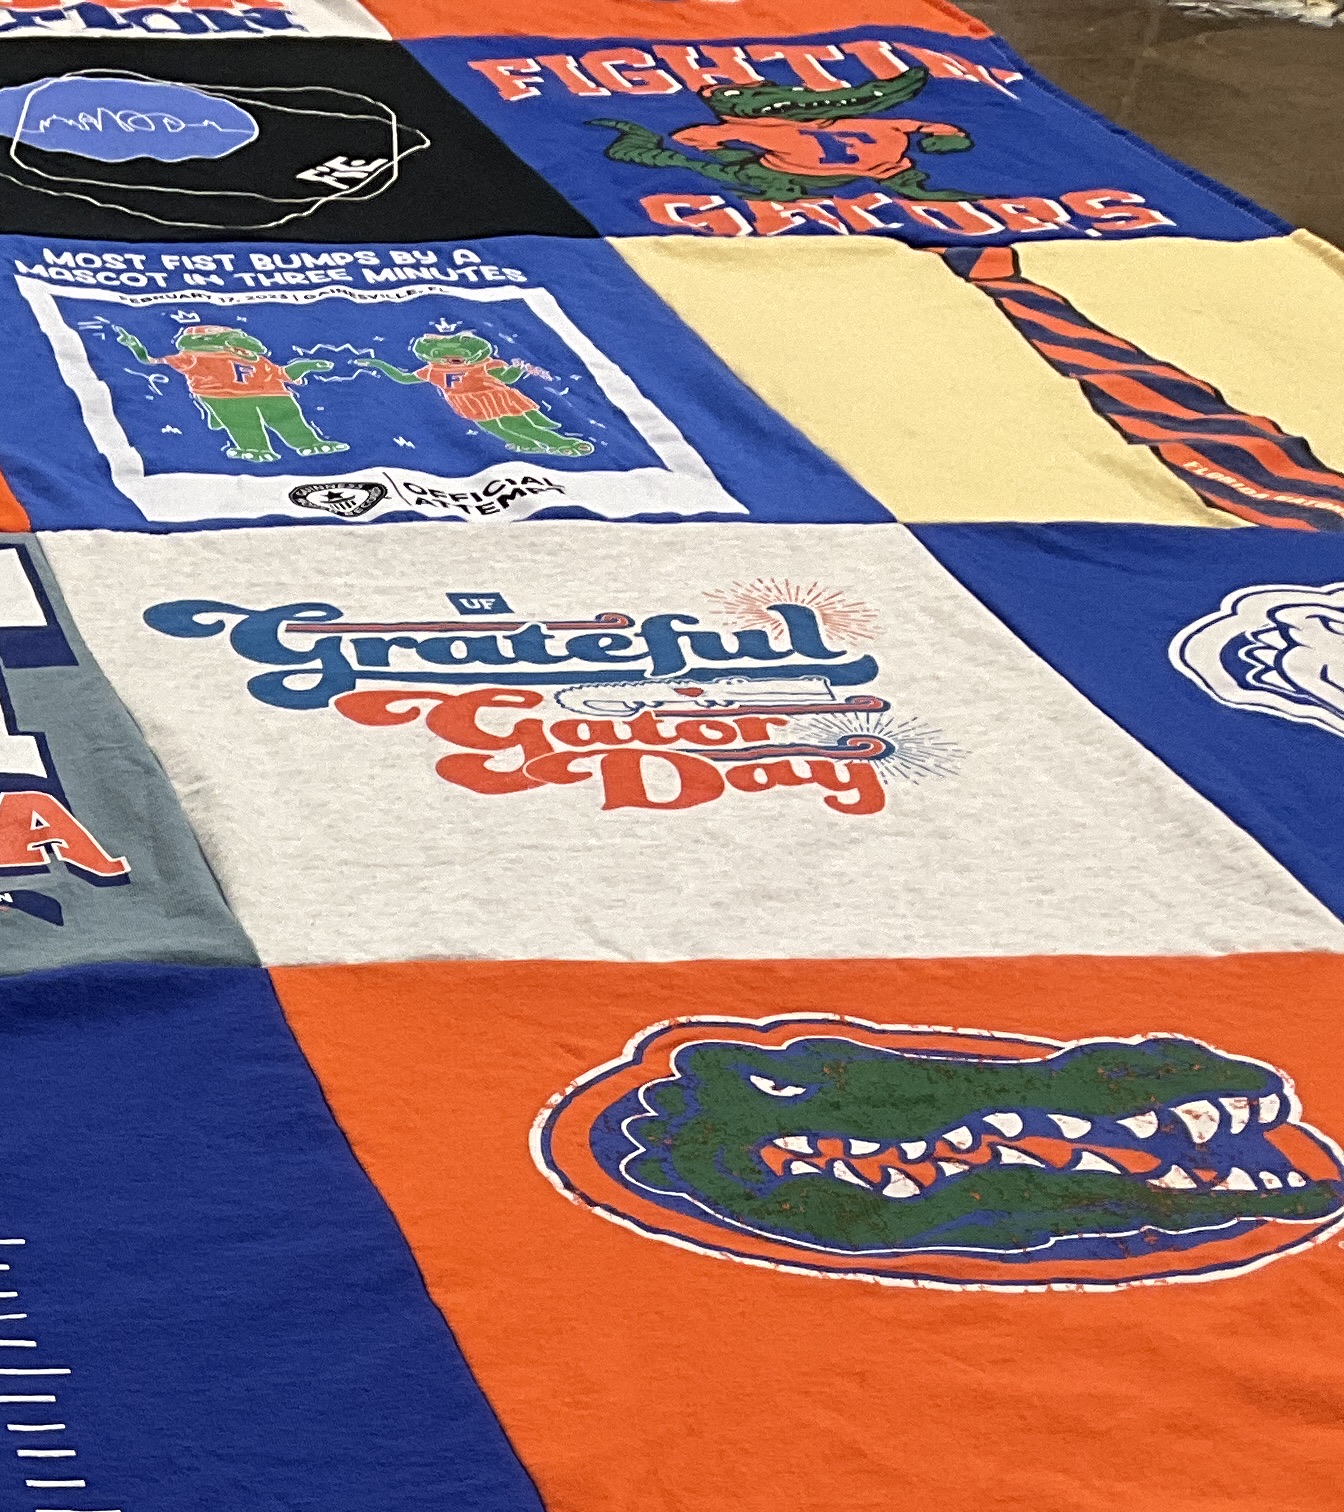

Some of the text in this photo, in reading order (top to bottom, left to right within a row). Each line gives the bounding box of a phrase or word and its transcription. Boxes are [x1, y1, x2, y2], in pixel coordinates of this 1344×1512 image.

[798, 128, 877, 165] F
[638, 188, 1178, 240] GATORS
[14, 259, 528, 288] MASCOT IN THREE MINUTES
[42, 247, 482, 272] MOST FIST BUMPS BY A
[231, 361, 257, 384] F
[442, 371, 467, 391] F
[402, 475, 565, 503] OFFICIAL
[459, 596, 496, 612] UF
[143, 596, 879, 710] Grateful
[330, 687, 792, 795] Gator
[517, 747, 887, 816] Day
